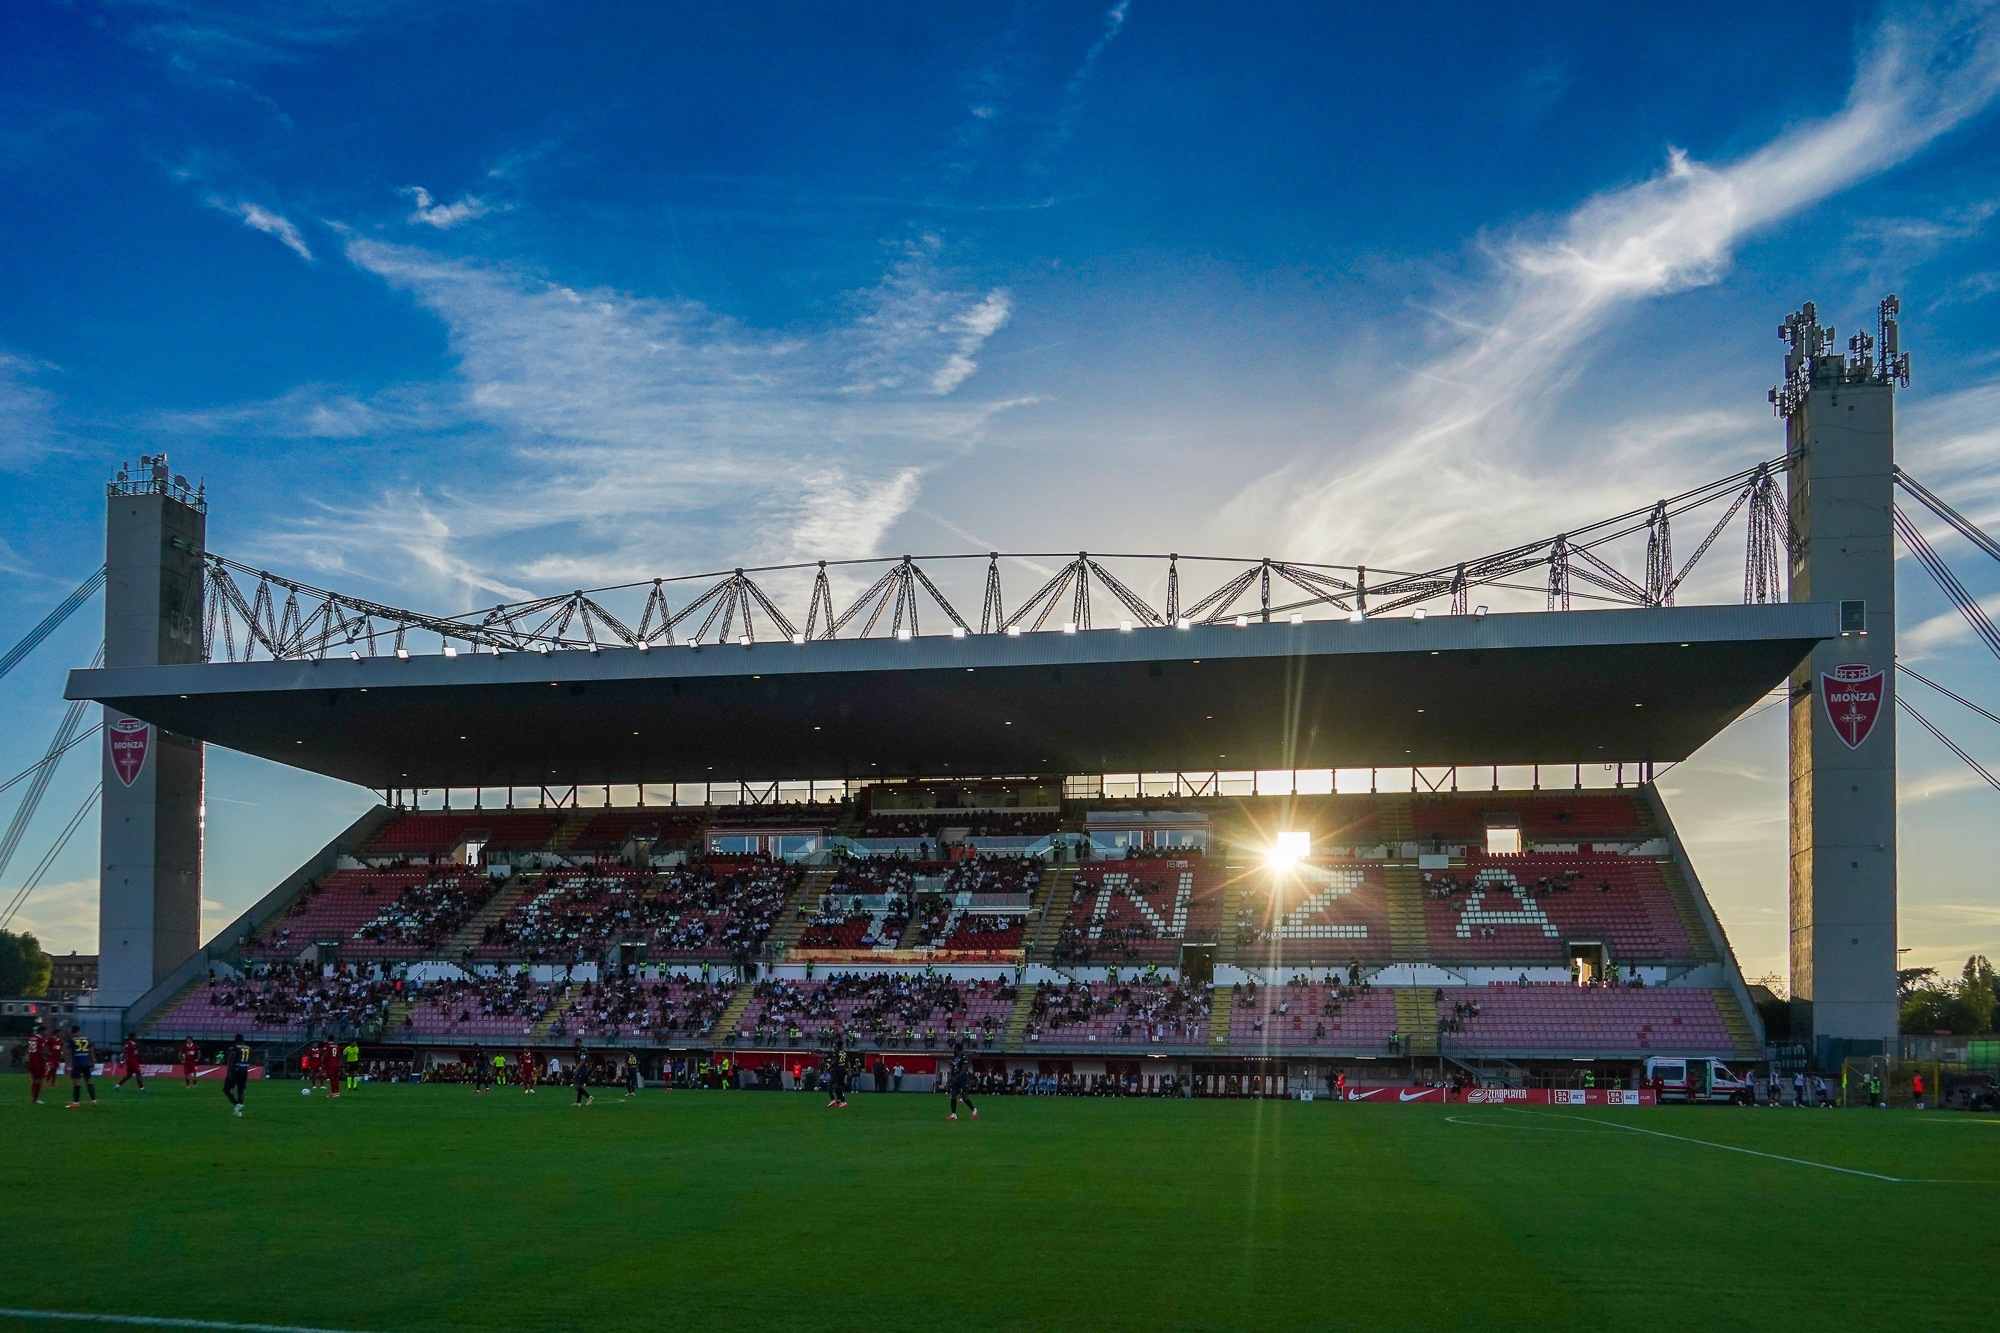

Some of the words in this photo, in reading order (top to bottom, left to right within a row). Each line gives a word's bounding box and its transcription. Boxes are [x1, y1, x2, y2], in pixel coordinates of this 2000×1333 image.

[1846, 684, 1860, 692] AC
[1831, 693, 1875, 703] MONZA
[73, 1039, 90, 1052] 32
[331, 1047, 338, 1057] 9
[1488, 1089, 1527, 1099] ZEROPLAYER
